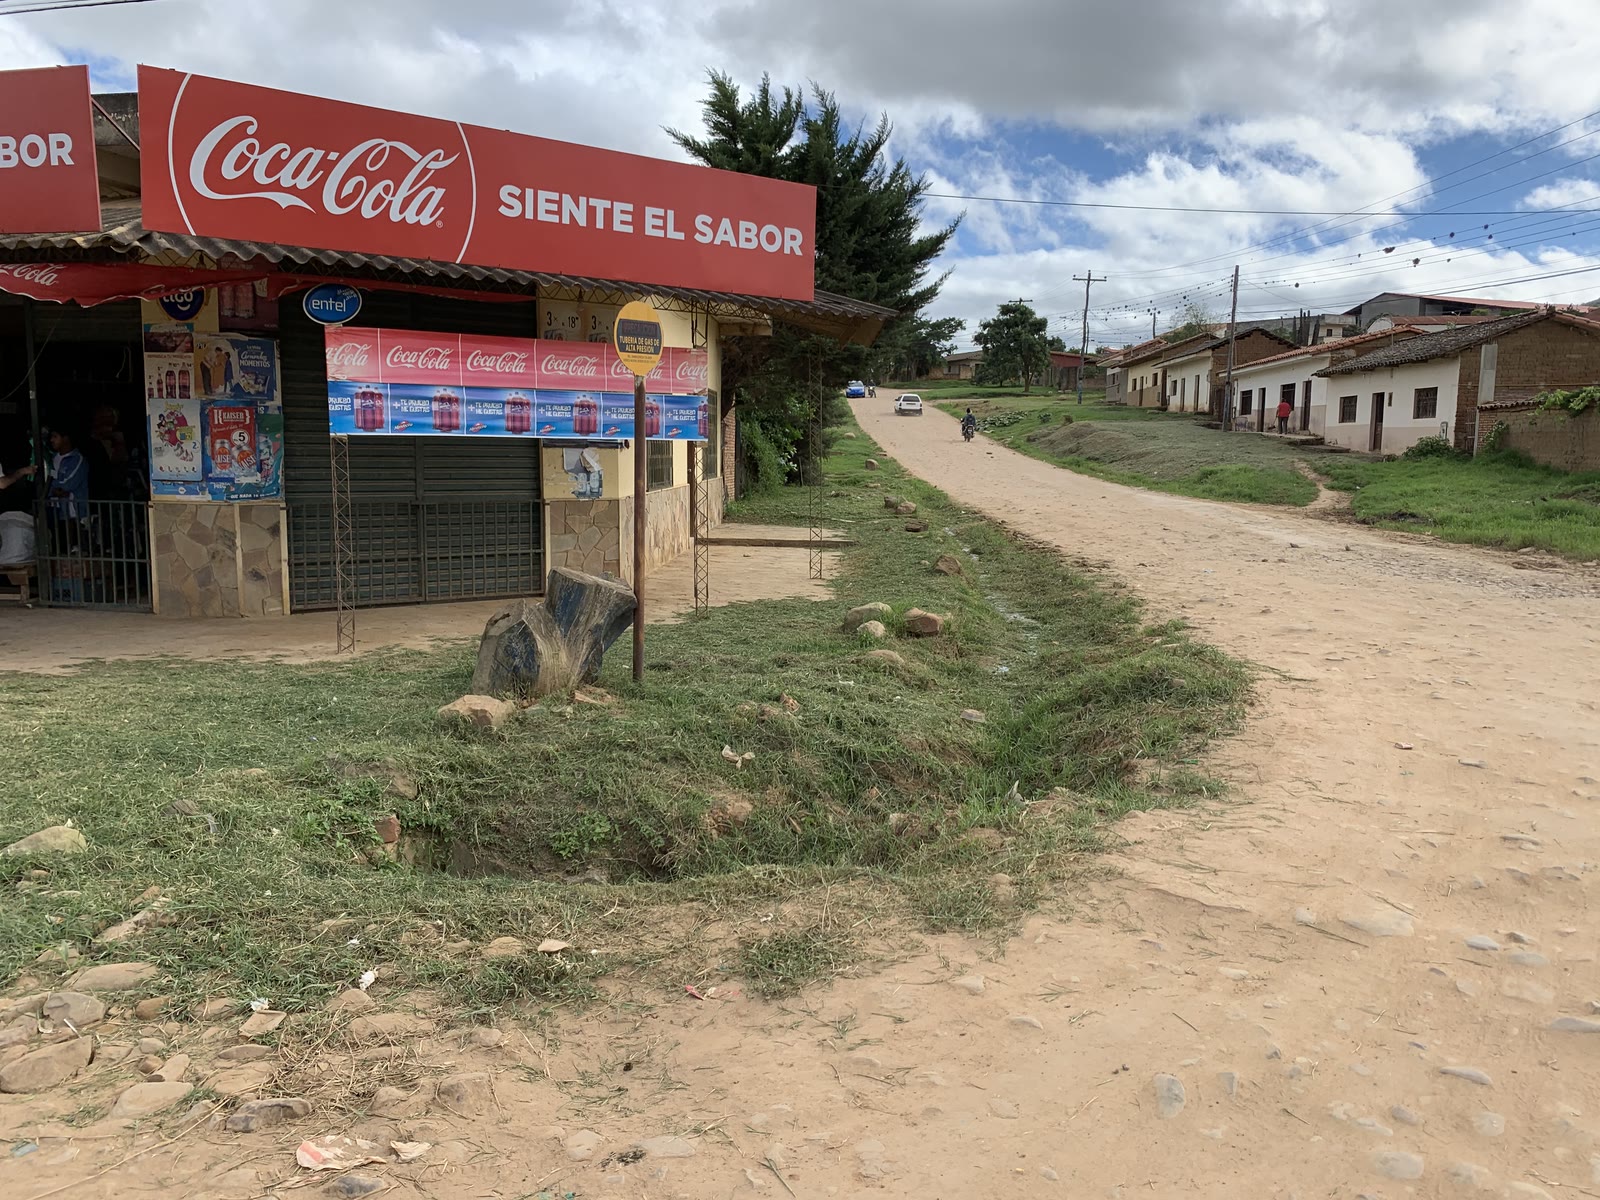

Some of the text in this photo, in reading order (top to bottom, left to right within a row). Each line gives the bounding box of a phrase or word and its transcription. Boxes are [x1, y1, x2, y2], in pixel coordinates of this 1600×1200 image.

[189, 115, 460, 228] Coca-Cola
[498, 183, 803, 256] SIENTE EL SABOR
[312, 297, 346, 312] entel
[638, 337, 644, 345] DE
[654, 339, 660, 347] DE
[386, 345, 454, 370] Coca-Cola
[467, 349, 529, 373] Coca-Cola
[541, 354, 599, 376] Coca-Cola
[223, 412, 245, 420] KAISER
[238, 432, 246, 442] 5
